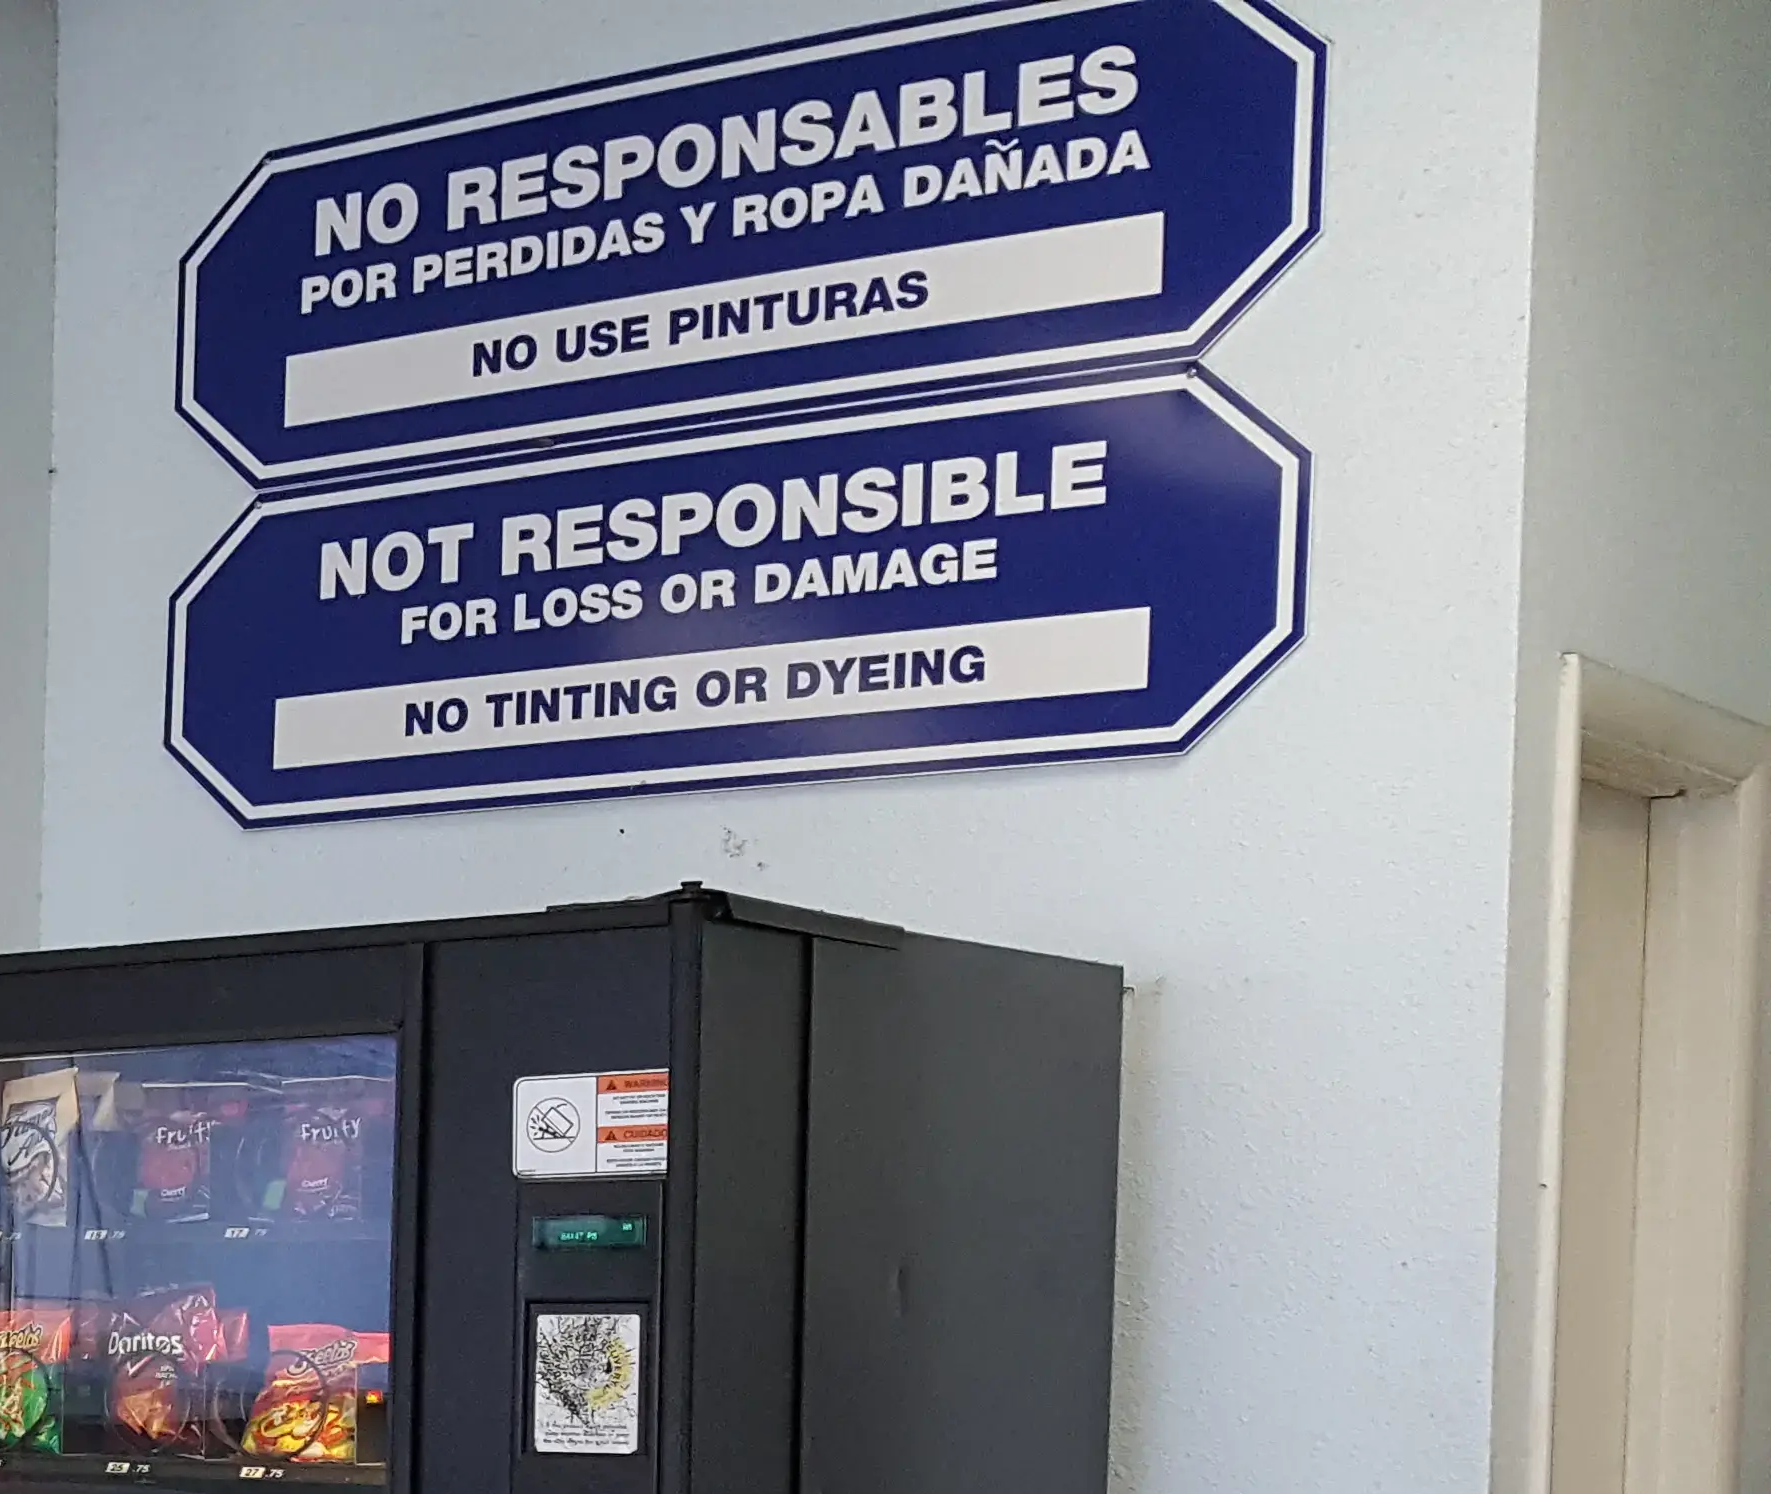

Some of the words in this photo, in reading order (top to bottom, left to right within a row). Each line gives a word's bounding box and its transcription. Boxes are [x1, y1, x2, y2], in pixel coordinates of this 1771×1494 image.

[313, 182, 419, 257] NO
[447, 46, 1139, 234] RESPONSABLES
[300, 262, 397, 315] POR
[412, 211, 665, 294] PERDIDAS
[679, 204, 714, 244] Y
[732, 174, 885, 237] ROPA
[903, 129, 1150, 208] DAÑADA
[472, 333, 538, 378] NO
[555, 314, 650, 363] USE
[668, 270, 929, 345] PINTURAS
[319, 521, 475, 600] NOT
[501, 440, 1109, 580] RESPONSIBLE
[400, 597, 497, 645] FOR
[513, 580, 643, 632] LOSS
[659, 567, 738, 613] OR
[754, 538, 999, 604] DAMAGE
[404, 697, 469, 738] NO
[485, 676, 678, 728] TINTING
[696, 664, 770, 707] OR
[786, 645, 987, 699] DYEING
[108, 1331, 184, 1355] Doritos
